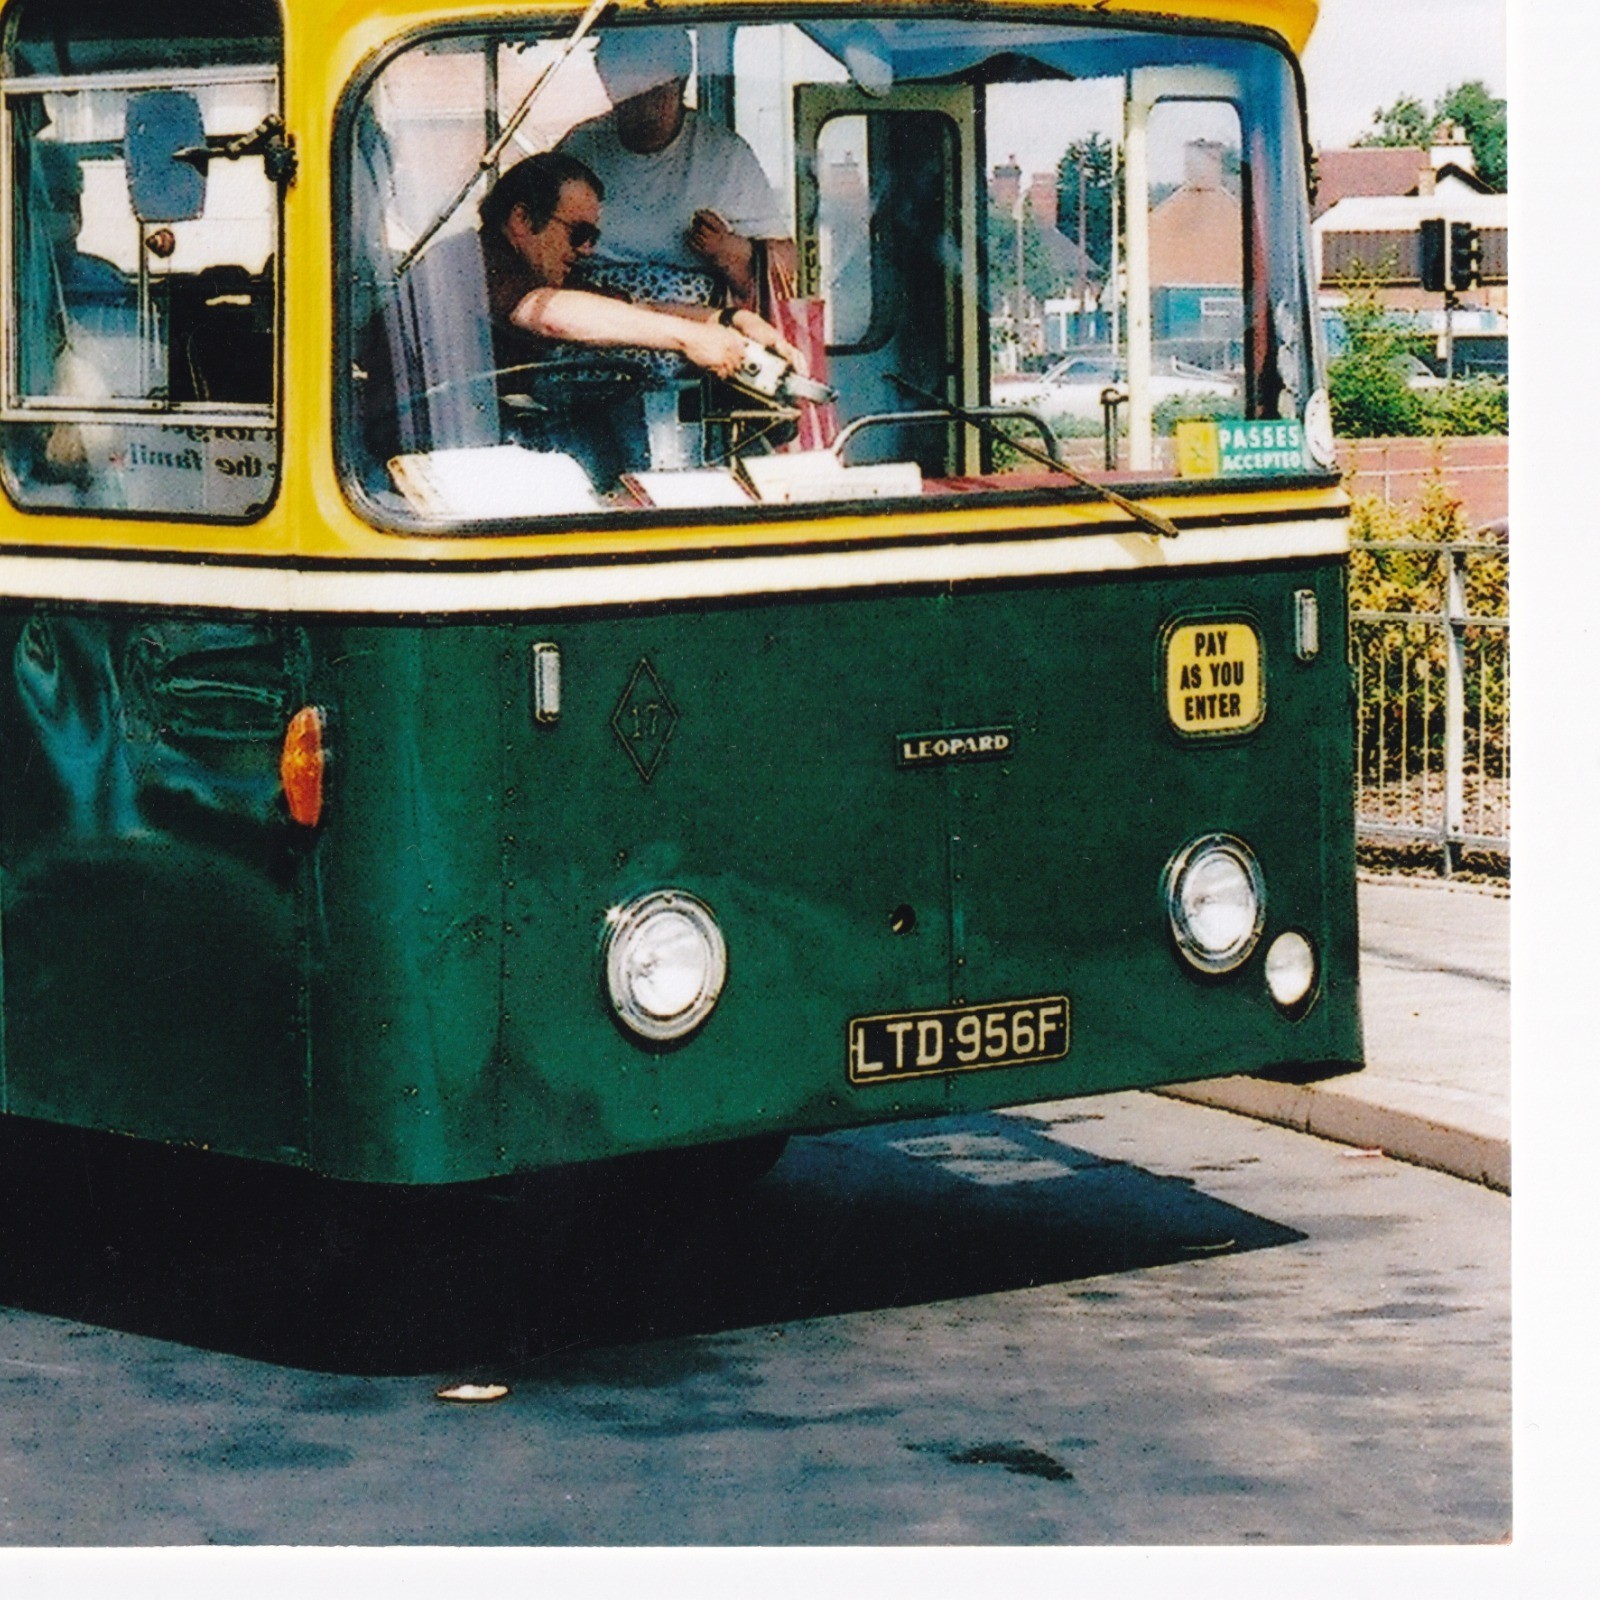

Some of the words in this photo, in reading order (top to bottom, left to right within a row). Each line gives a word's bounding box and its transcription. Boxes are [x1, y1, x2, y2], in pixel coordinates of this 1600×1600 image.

[804, 240, 817, 295] PULL
[1219, 425, 1299, 451] PASSES
[1222, 451, 1301, 470] ACCEPTED
[1195, 630, 1228, 657] PAY
[1180, 663, 1202, 690] AS
[1209, 660, 1244, 687] YOU
[631, 703, 660, 738] 17
[1184, 692, 1241, 721] ENTER
[903, 734, 1009, 759] LEOPARD
[857, 1019, 943, 1073] LTD
[956, 1005, 1062, 1062] 956F
